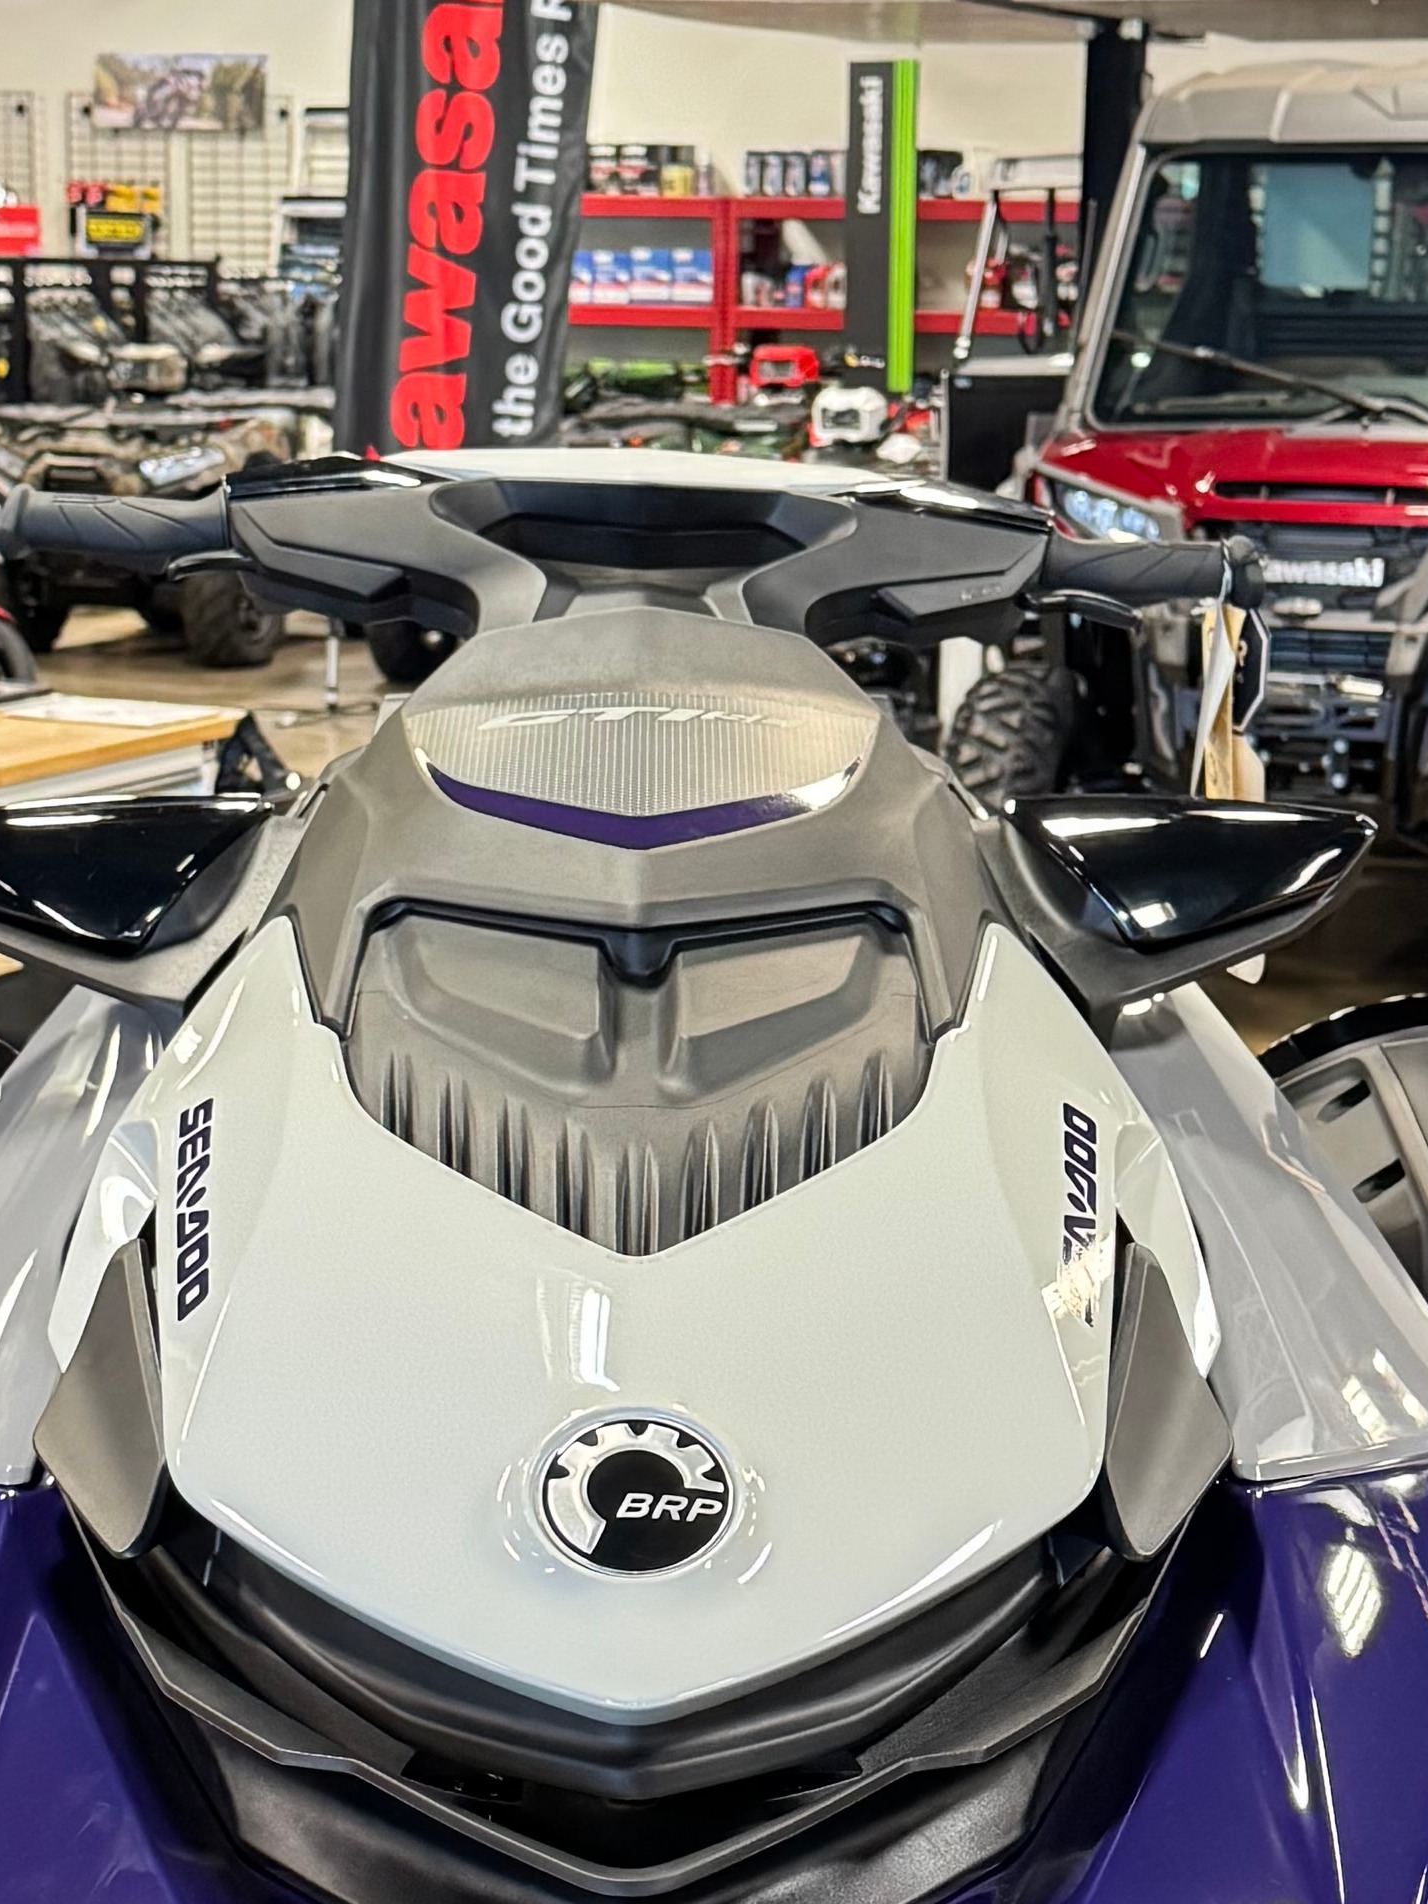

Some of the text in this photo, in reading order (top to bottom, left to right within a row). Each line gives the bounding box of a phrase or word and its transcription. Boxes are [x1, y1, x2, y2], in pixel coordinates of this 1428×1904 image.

[514, 32, 570, 193] Times
[501, 201, 553, 343] Good
[491, 352, 540, 437] the
[1259, 556, 1386, 588] awasaki
[477, 705, 704, 731] GTI
[615, 1492, 723, 1523] BRP
